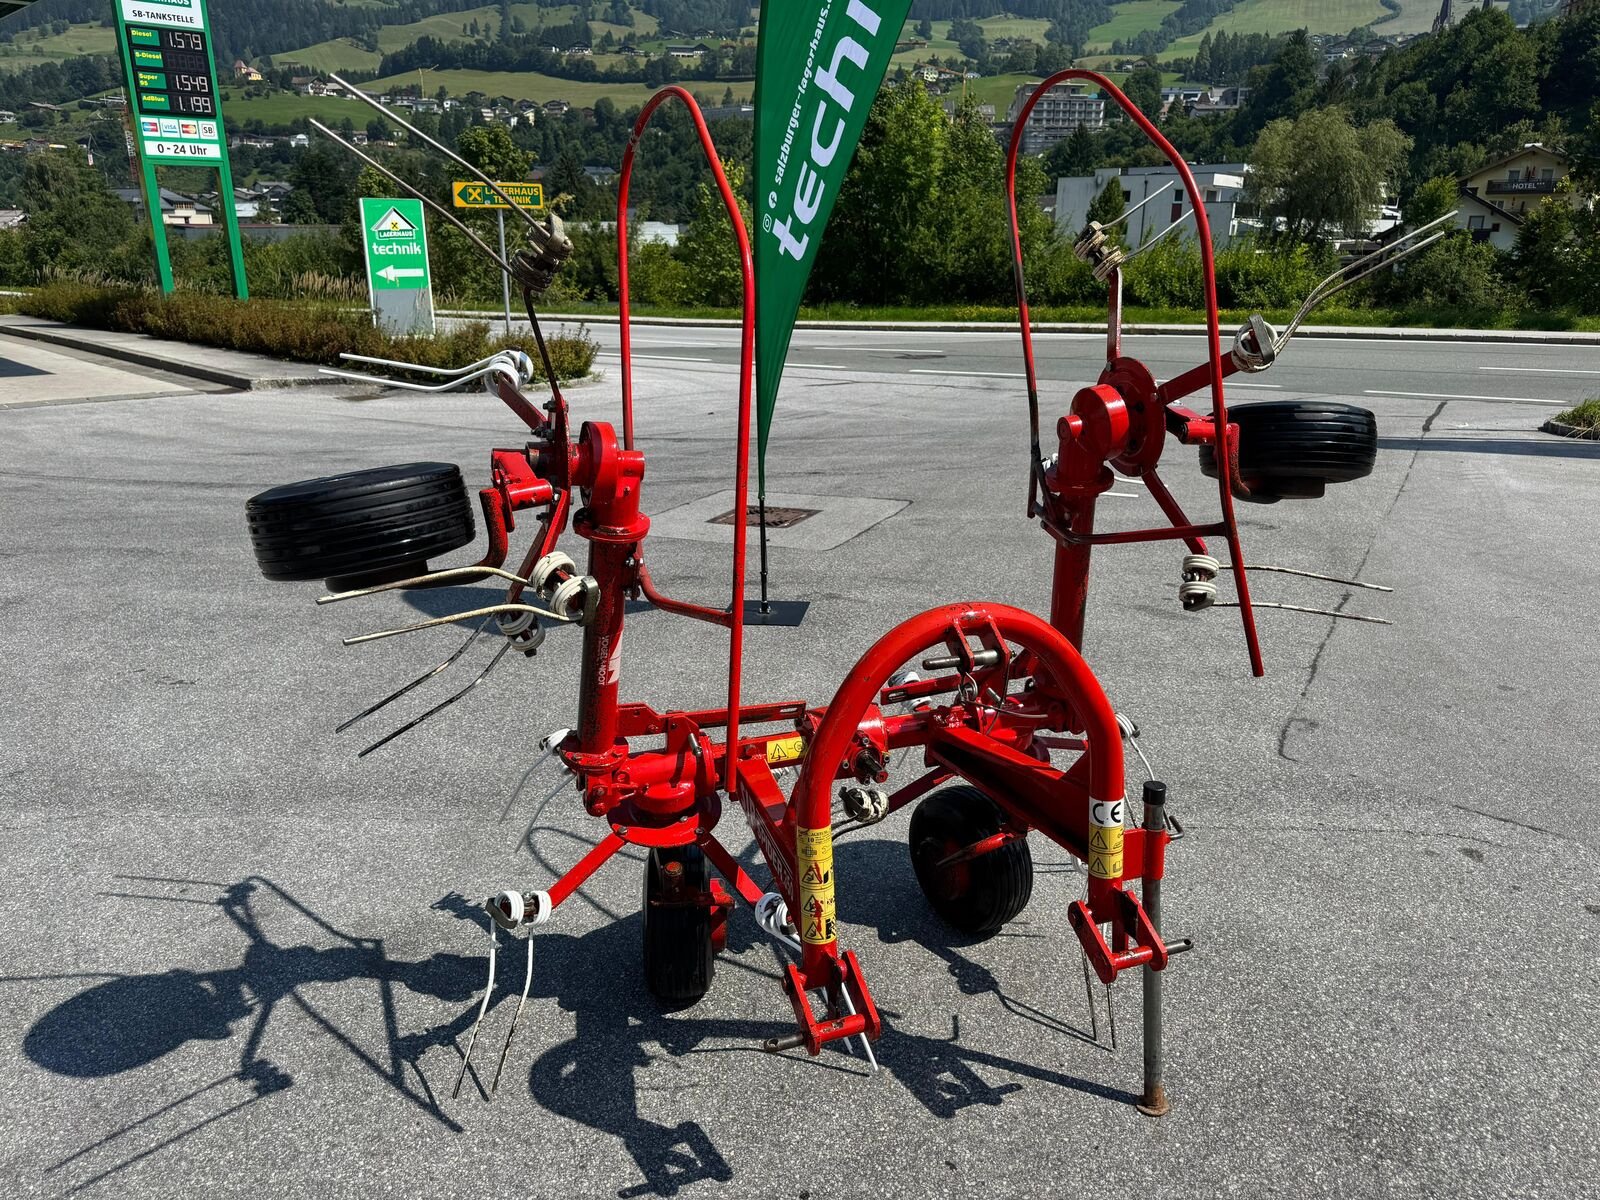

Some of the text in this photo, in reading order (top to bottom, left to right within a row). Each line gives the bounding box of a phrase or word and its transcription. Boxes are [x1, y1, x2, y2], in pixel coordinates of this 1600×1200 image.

[132, 9, 195, 24] SB-TANKSTELLE
[131, 29, 152, 37] Diesel
[169, 31, 203, 51] 1.579
[138, 73, 158, 81] Super
[175, 74, 209, 93] 1.549
[179, 95, 212, 113] 1.199
[203, 126, 213, 134] SB
[157, 143, 165, 154] 0
[173, 144, 186, 155] 24
[189, 144, 208, 156] Uhr
[484, 187, 539, 196] LAERHAUS
[379, 230, 414, 238] LAGERHAUS
[371, 241, 422, 255] technik
